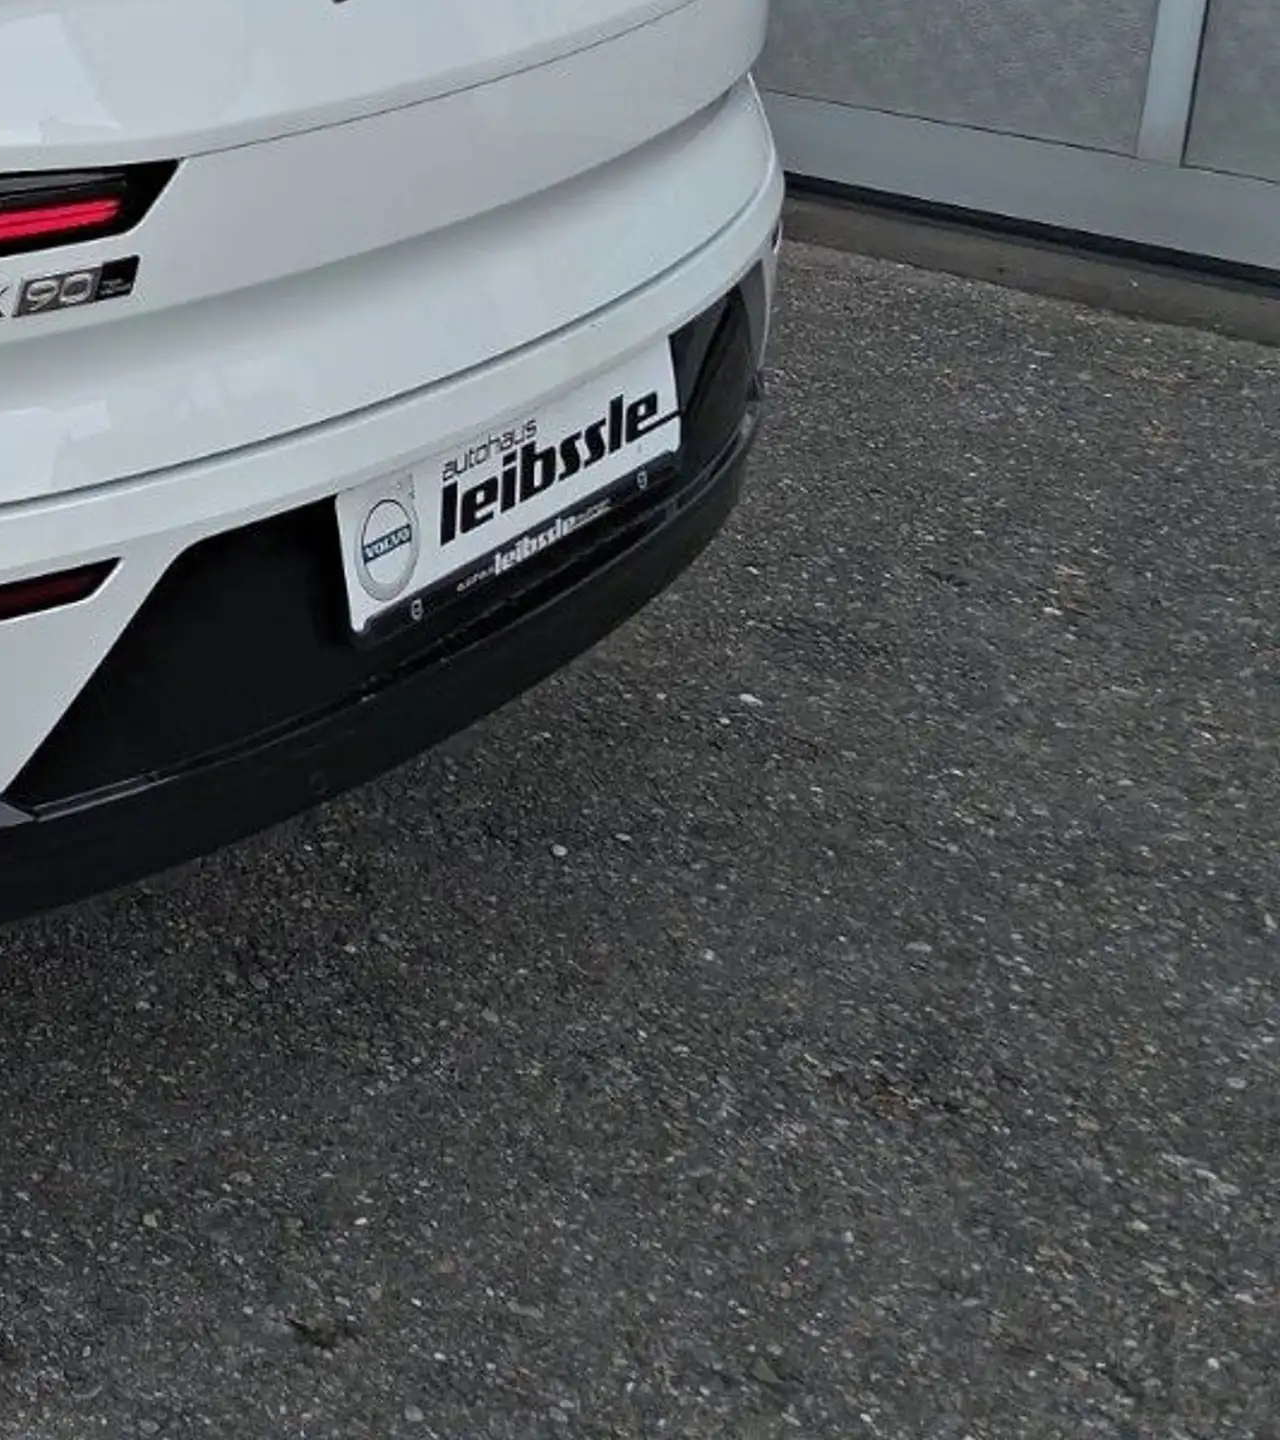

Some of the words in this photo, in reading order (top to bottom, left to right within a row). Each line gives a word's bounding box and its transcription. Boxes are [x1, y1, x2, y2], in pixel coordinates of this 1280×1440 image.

[440, 391, 670, 547] leibssle
[442, 419, 537, 481] autohaus
[364, 525, 411, 560] VOLVO
